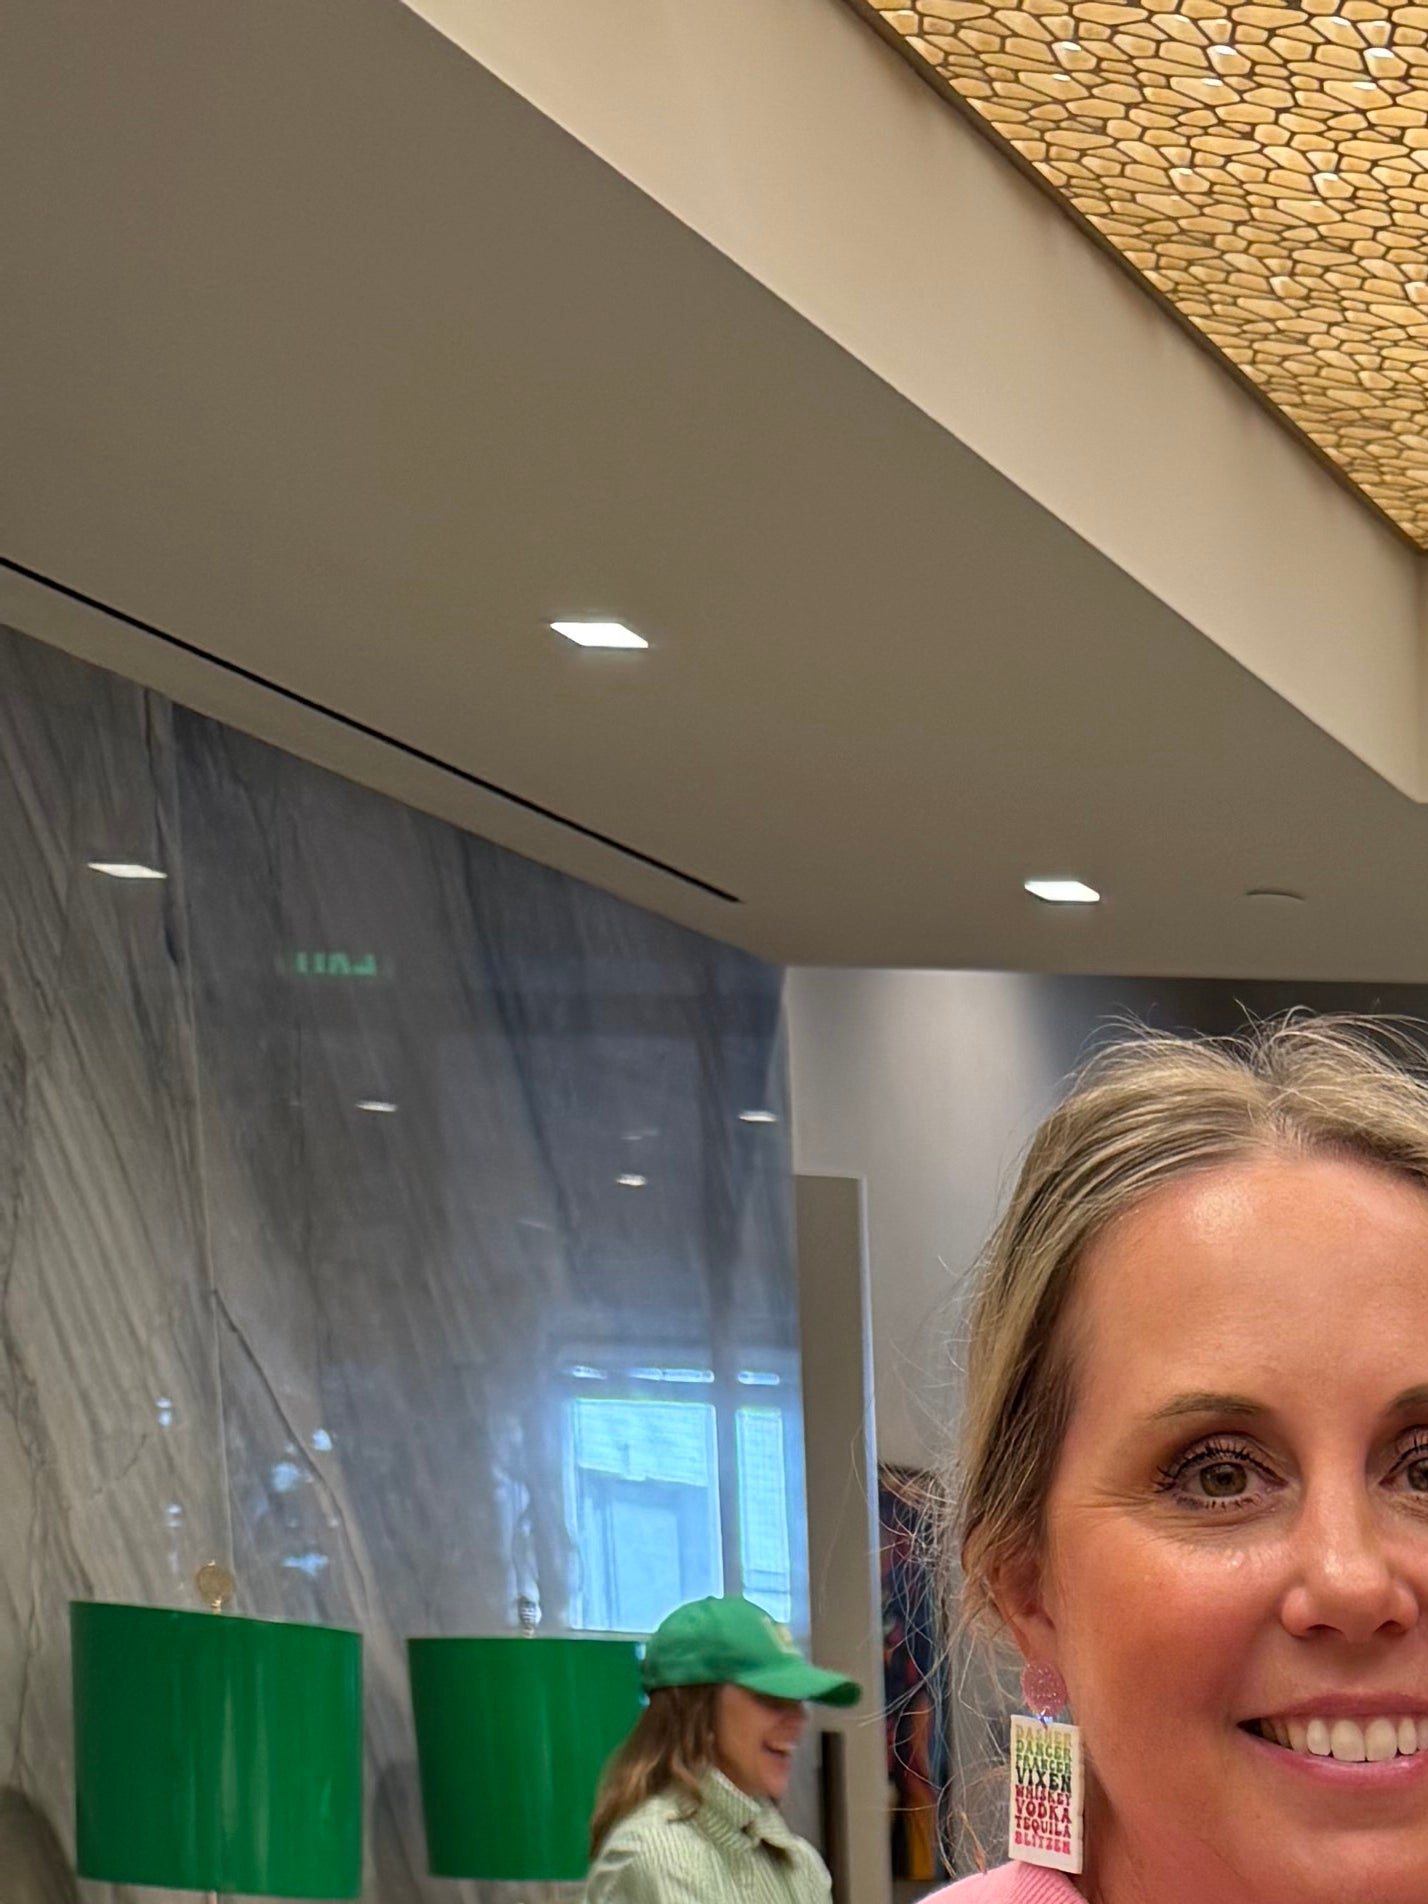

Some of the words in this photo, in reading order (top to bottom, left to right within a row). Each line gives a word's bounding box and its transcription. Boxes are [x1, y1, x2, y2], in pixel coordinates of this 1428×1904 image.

[1015, 1725, 1071, 1746] DASHER
[1016, 1740, 1072, 1762] DANCER
[1016, 1754, 1072, 1774] PRANCER
[1016, 1766, 1071, 1793] VIXEN
[1015, 1785, 1071, 1806] WHISKEY
[1015, 1799, 1072, 1824] VODKA
[1015, 1815, 1071, 1839] TEQUILA
[1015, 1831, 1071, 1854] BLITZEN
